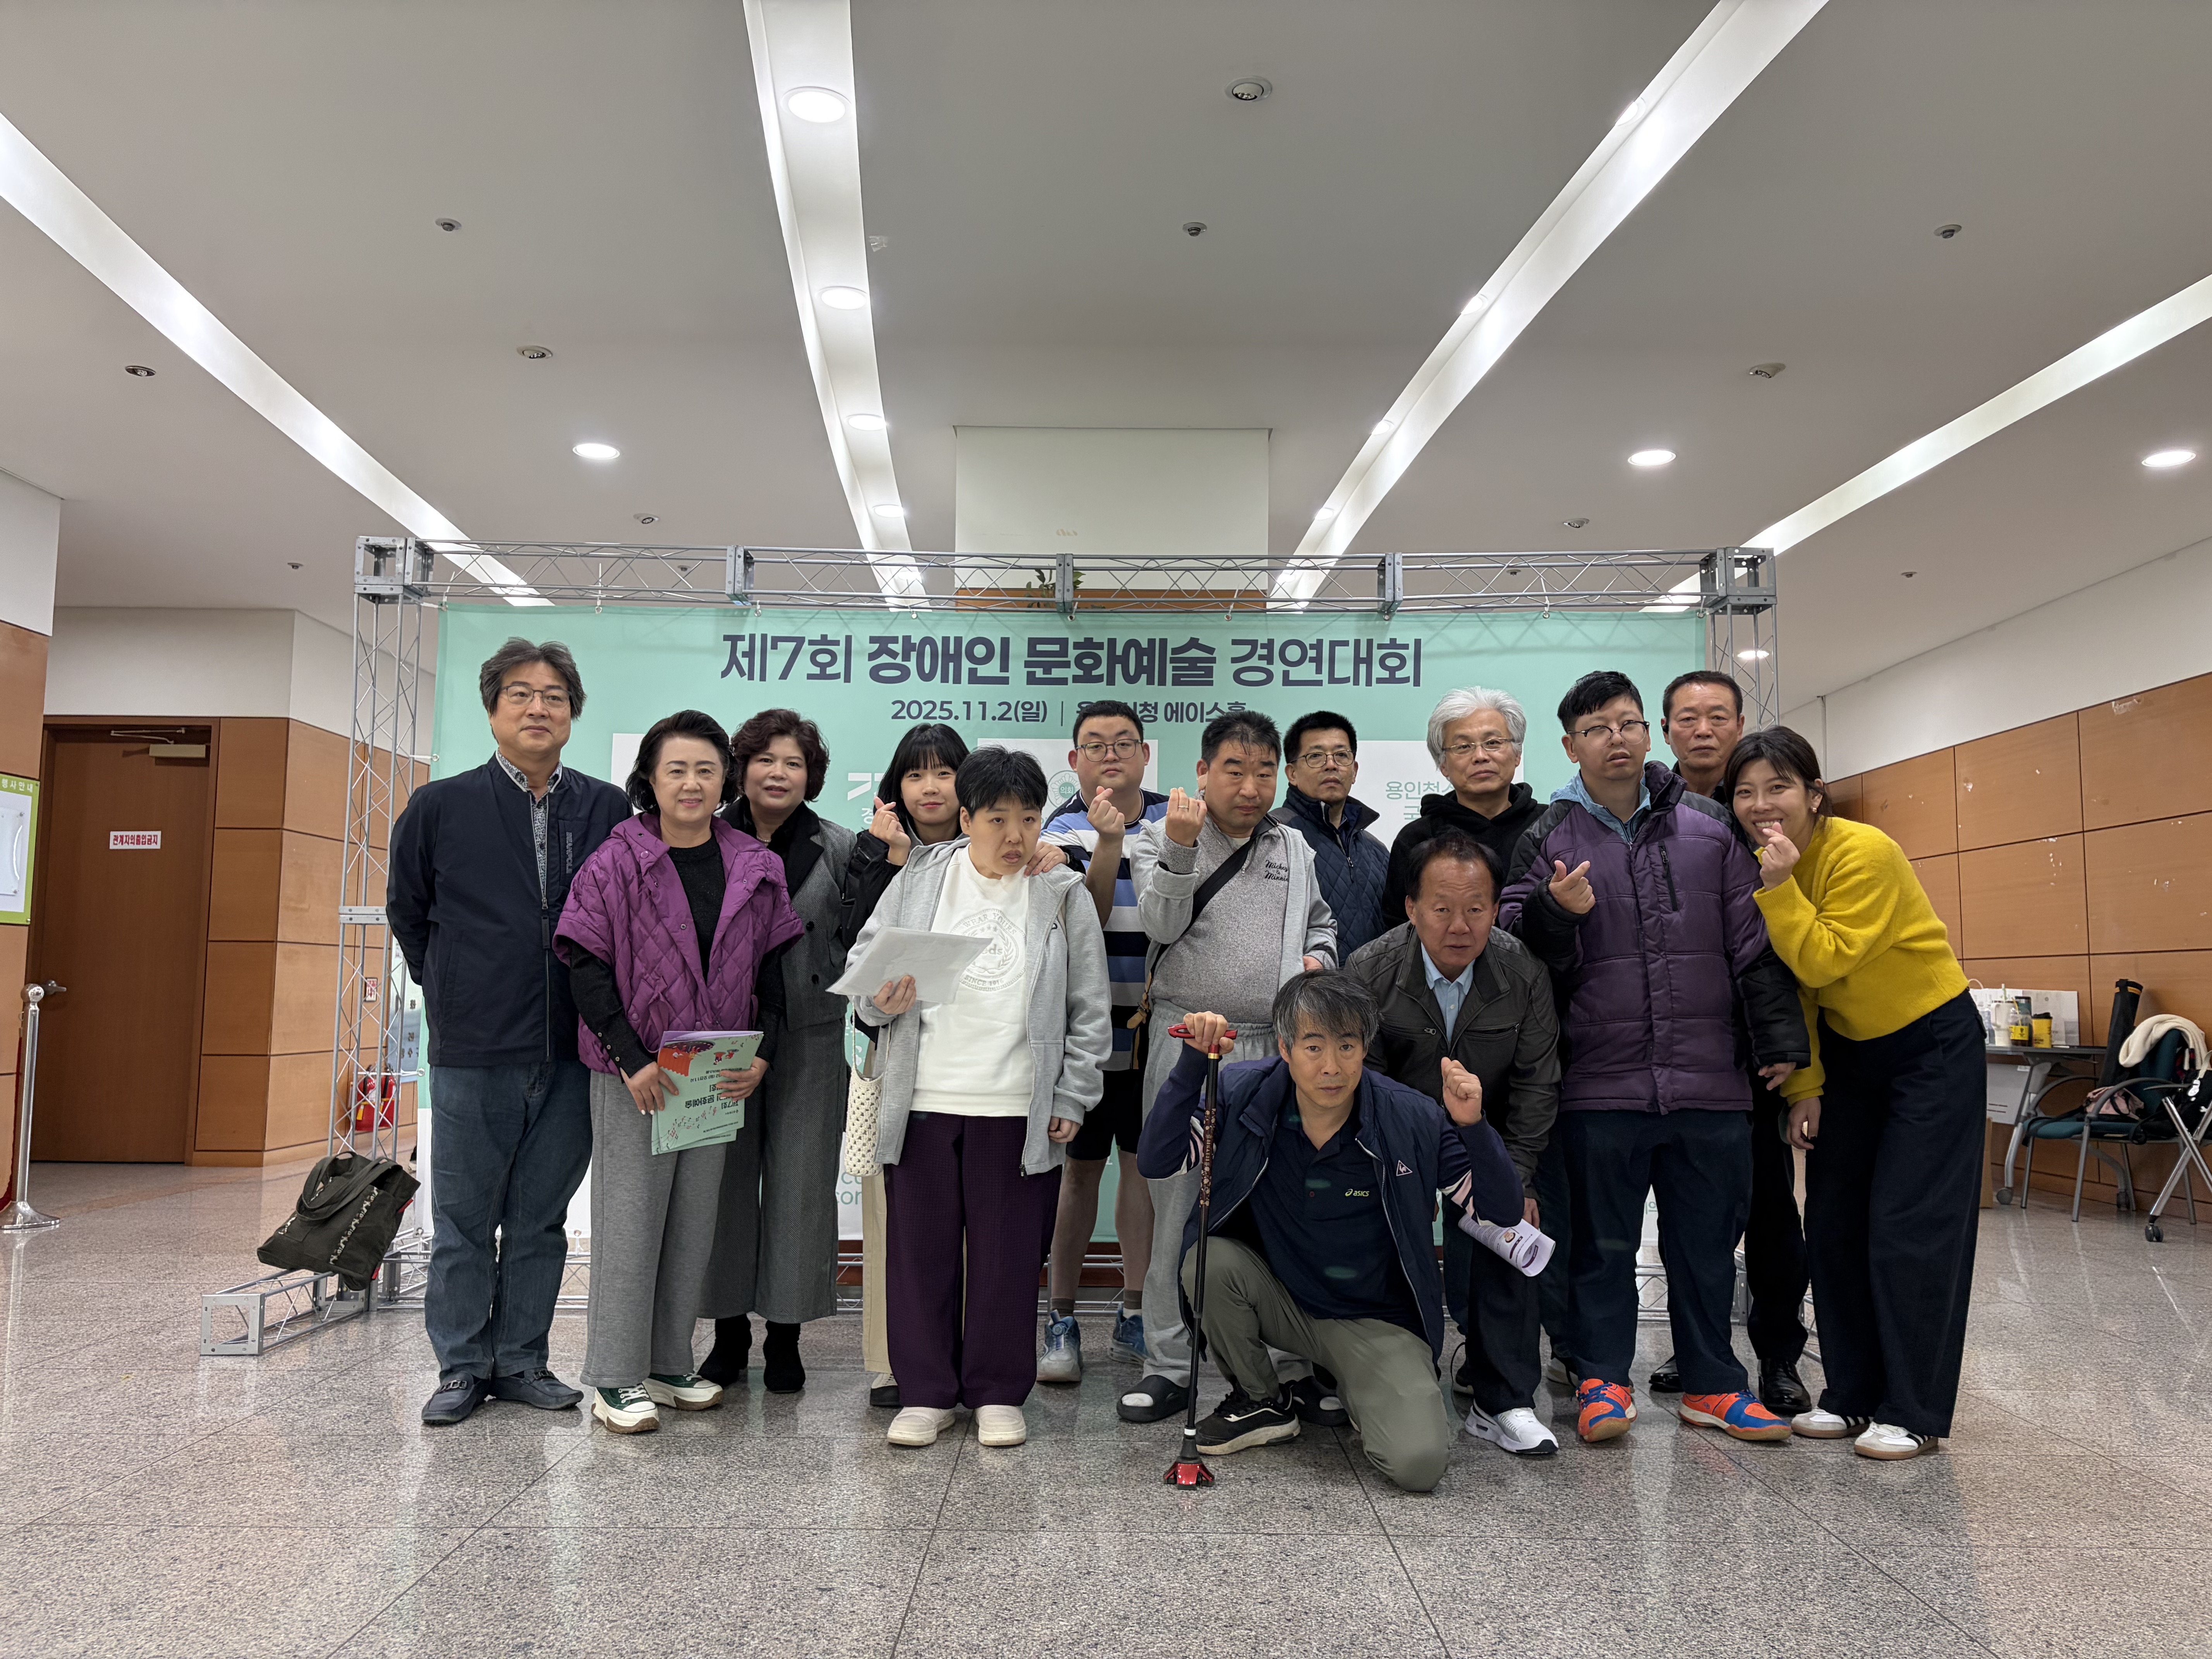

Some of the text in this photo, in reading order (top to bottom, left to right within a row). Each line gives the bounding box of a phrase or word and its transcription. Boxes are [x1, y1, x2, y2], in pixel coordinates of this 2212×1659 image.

[720, 634, 1422, 687] 제7회 장애인 문화예술 경연대회
[891, 700, 1047, 723] 2025.11.2(일)
[2, 778, 33, 793] 행사안내
[1060, 786, 1073, 794] 의회
[1265, 860, 1288, 872] Mickey
[963, 913, 1017, 935] WEAR YOURS
[964, 975, 987, 986] SINCE
[685, 1094, 714, 1109] 문화예술
